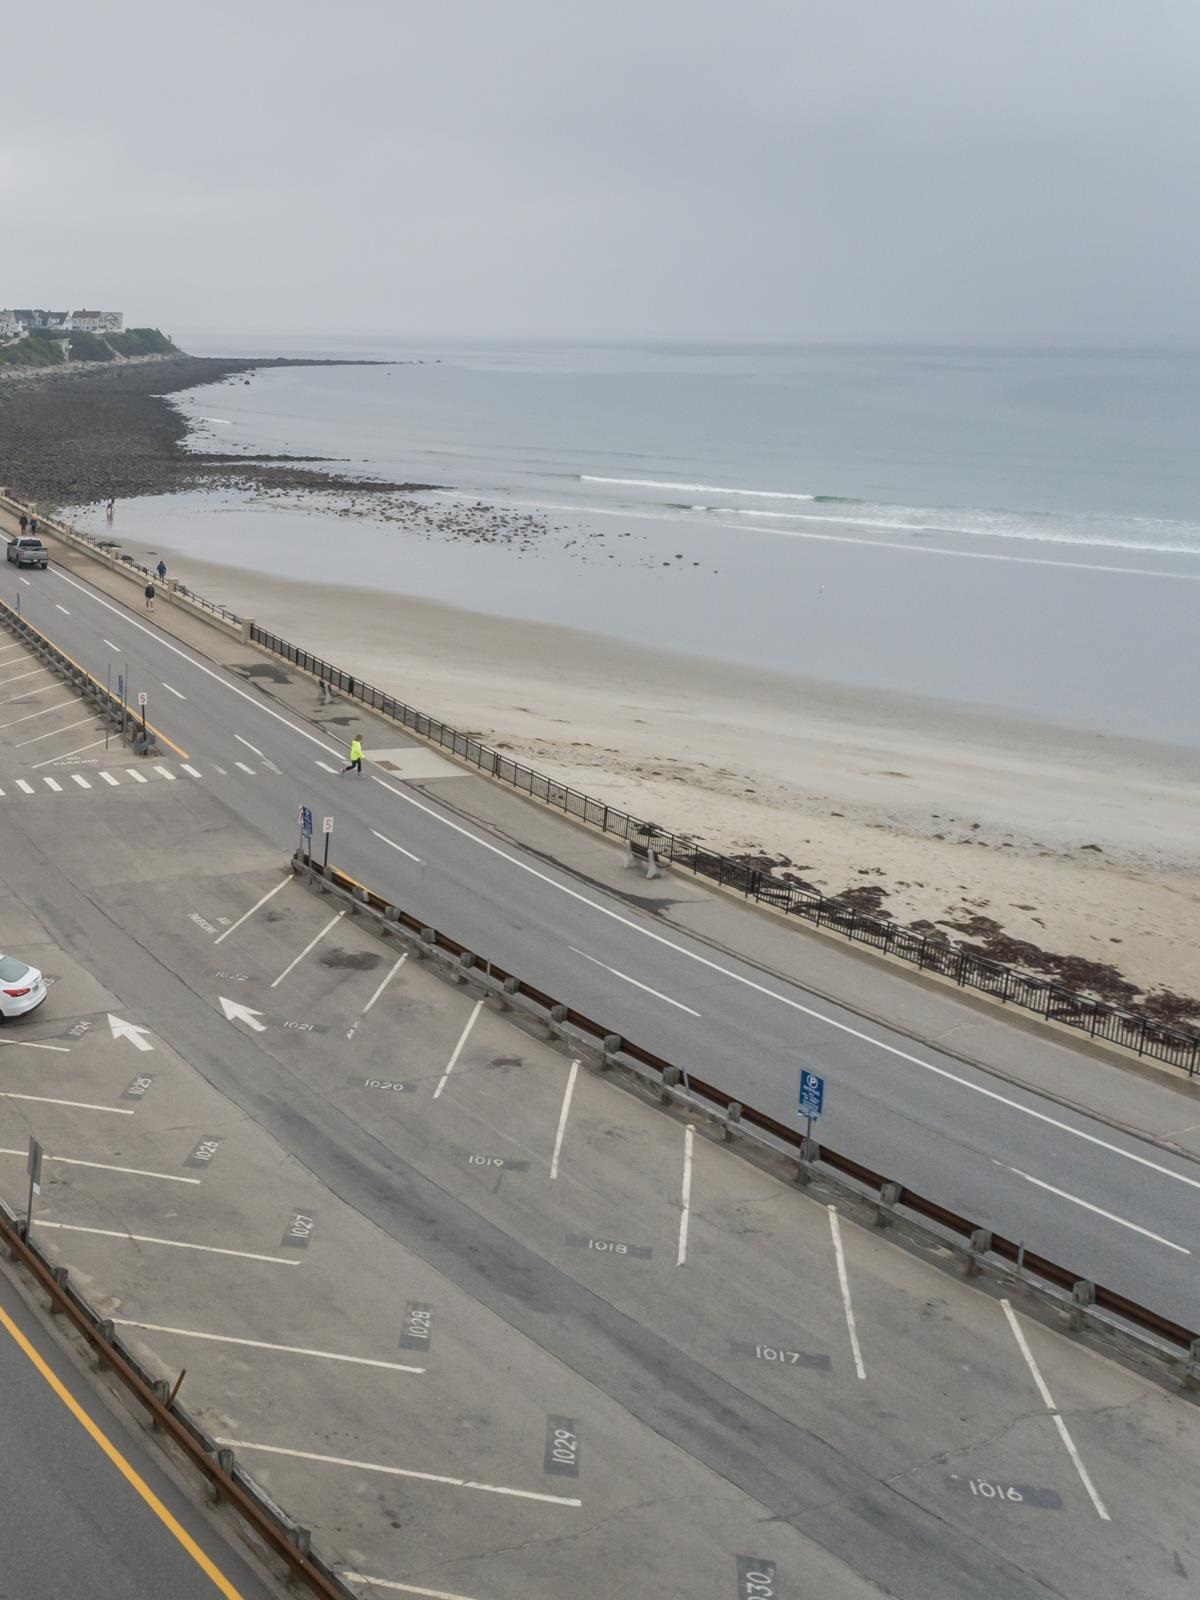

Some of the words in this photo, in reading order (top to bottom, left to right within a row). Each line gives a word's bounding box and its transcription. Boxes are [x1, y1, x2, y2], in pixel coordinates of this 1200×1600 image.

[325, 819, 332, 830] 5
[69, 1020, 92, 1036] 1024
[284, 1021, 314, 1031] 1021
[128, 1077, 152, 1095] 1025
[364, 1079, 404, 1091] 1020
[194, 1140, 219, 1160] 1026
[468, 1155, 504, 1167] 1019
[290, 1214, 313, 1237] 1027
[588, 1239, 628, 1254] 1018
[408, 1310, 431, 1338] 1028
[756, 1344, 800, 1364] 1017
[552, 1429, 577, 1465] 1029
[969, 1479, 1023, 1501] 1016
